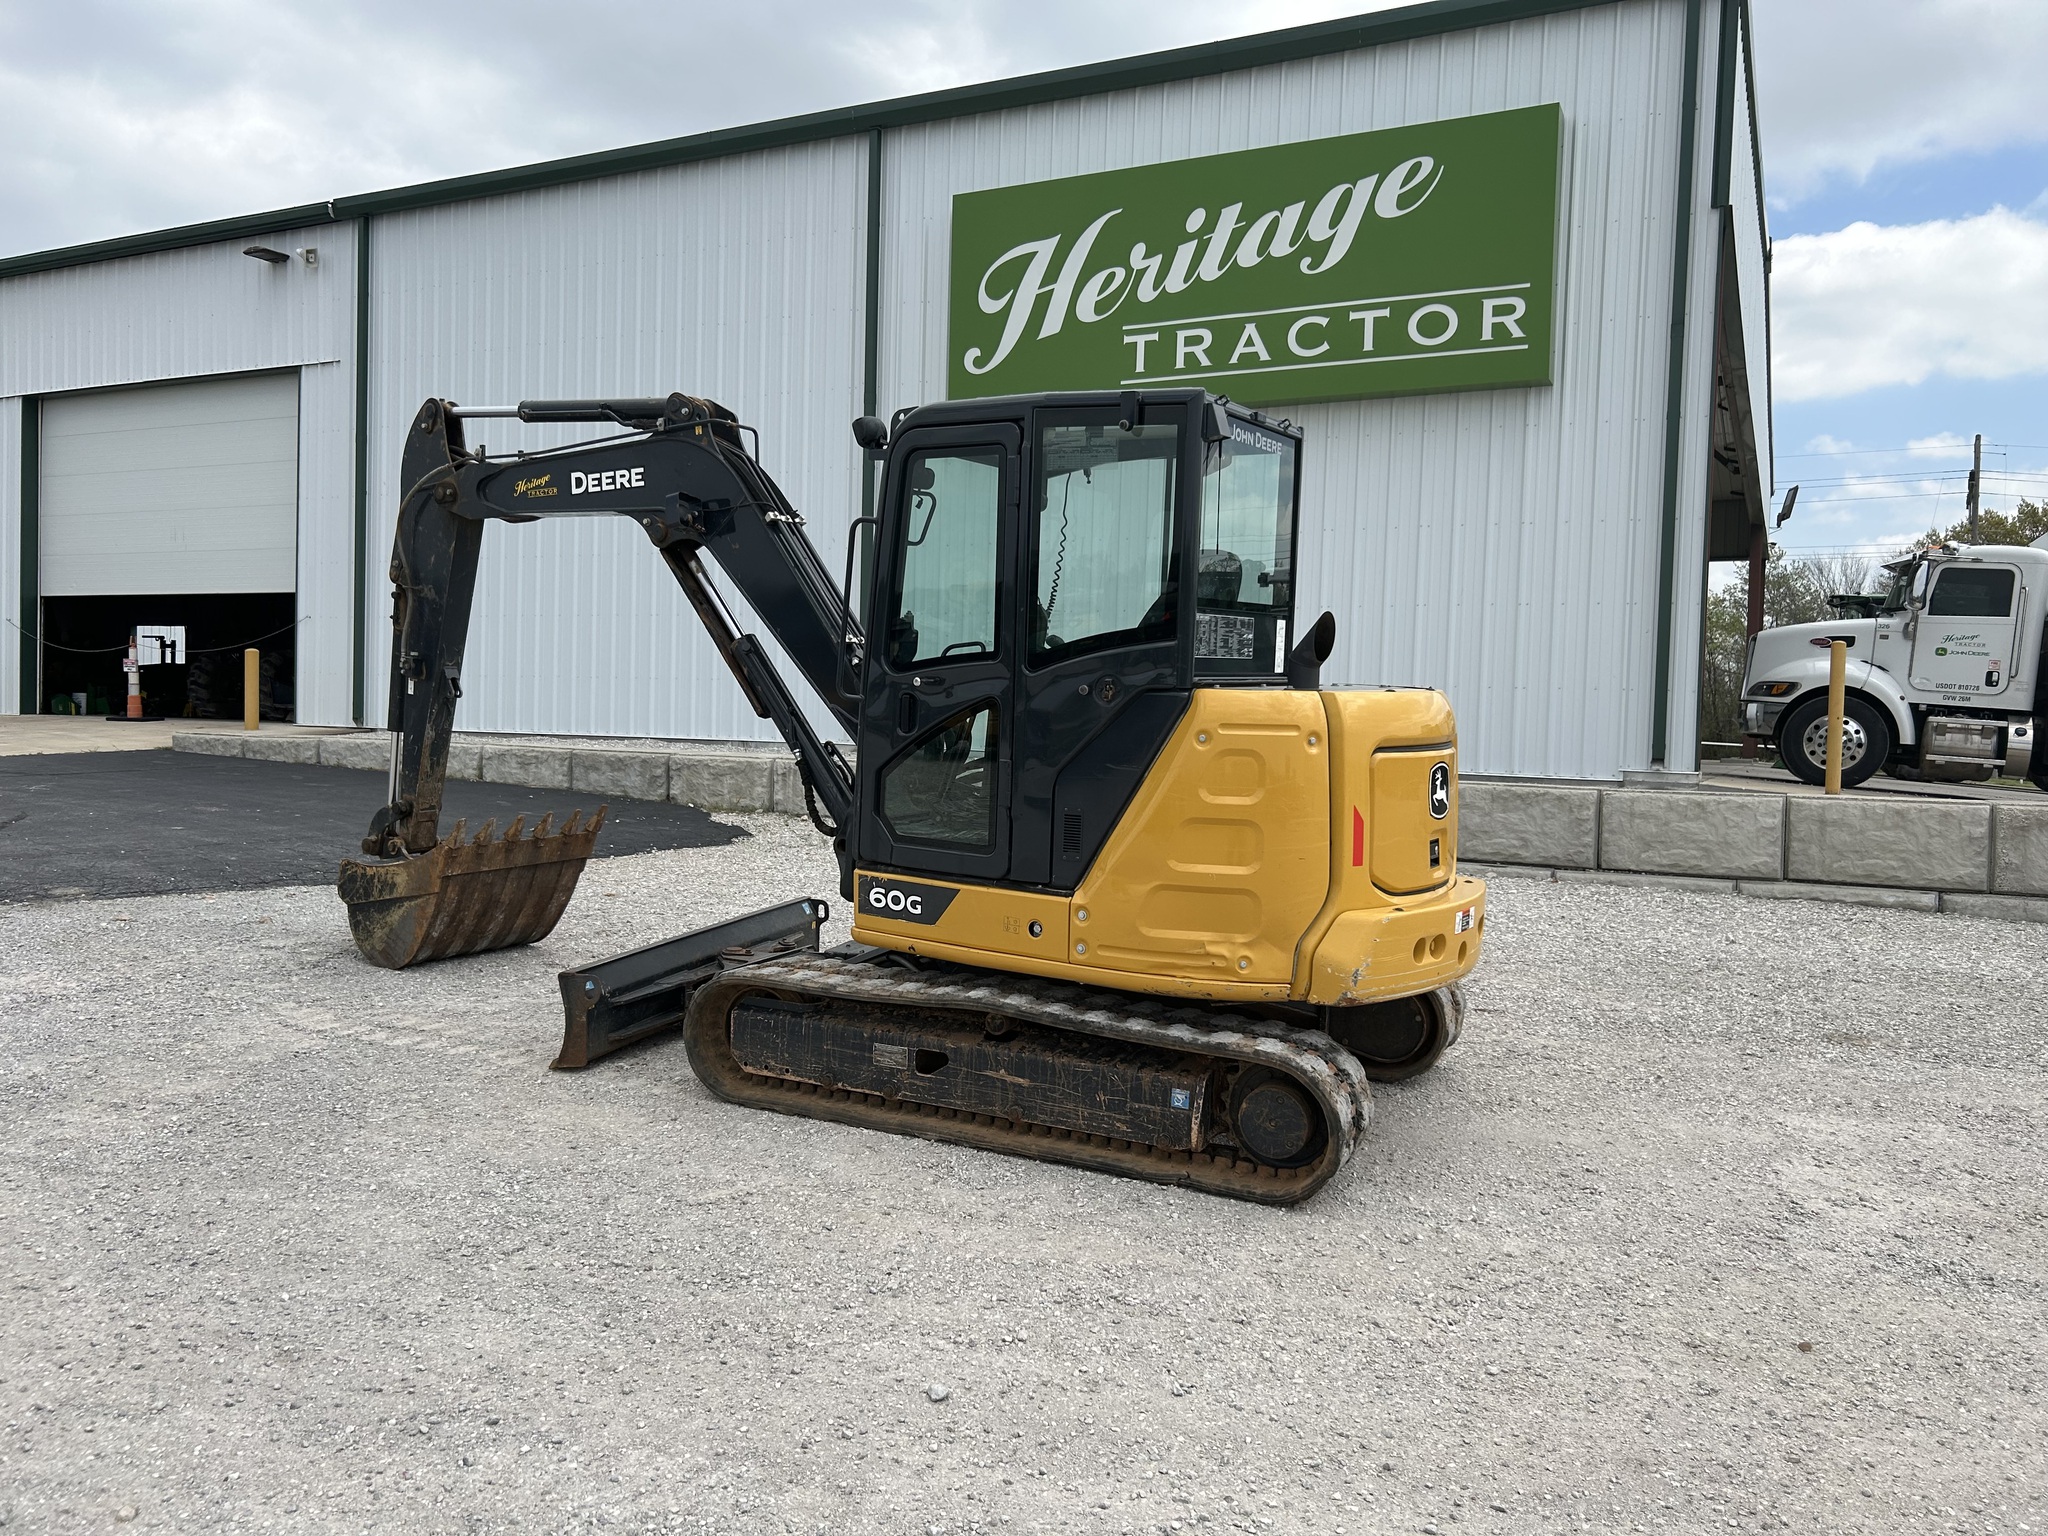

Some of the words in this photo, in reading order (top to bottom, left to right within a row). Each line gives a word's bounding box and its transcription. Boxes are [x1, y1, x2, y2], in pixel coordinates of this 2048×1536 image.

[963, 155, 1444, 375] Heritage
[1123, 296, 1527, 373] TRACTOR
[1231, 424, 1254, 446] JOHN
[1255, 431, 1283, 455] DEERE
[513, 474, 551, 497] Heritage
[527, 488, 558, 498] TRACTOR
[570, 467, 645, 495] DEERE
[1940, 634, 1980, 644] Heritage
[1935, 682, 1957, 690] USDOT
[1942, 694, 1957, 702] GVW
[869, 887, 922, 915] 60G
